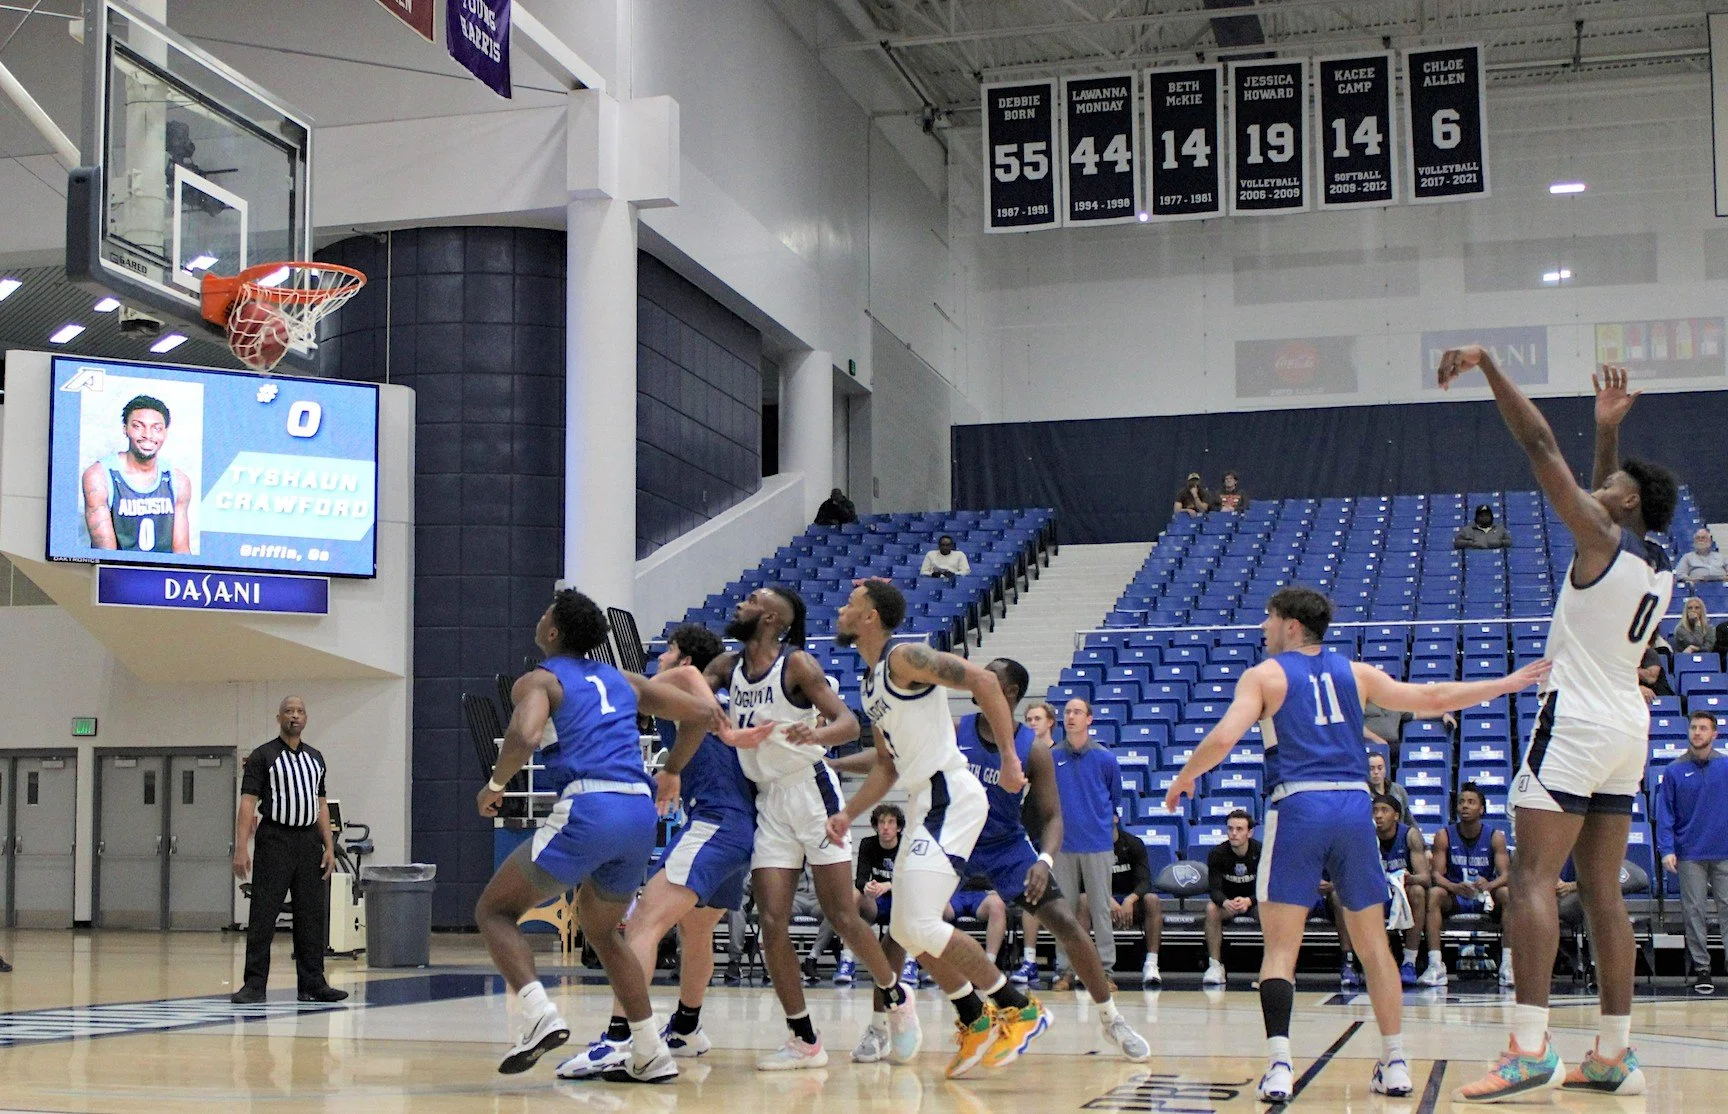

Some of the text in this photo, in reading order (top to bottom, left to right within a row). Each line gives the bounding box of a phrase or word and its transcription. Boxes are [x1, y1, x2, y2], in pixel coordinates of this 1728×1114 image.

[458, 14, 501, 63] HARRIS
[1334, 67, 1376, 81] KACEE
[1422, 59, 1464, 73] CHLOE
[1168, 80, 1200, 93] BETH
[1243, 74, 1294, 87] JESSICA
[1337, 81, 1373, 94] CAMP
[1423, 72, 1465, 87] ALLEN
[998, 95, 1041, 109] DEBBIE
[1072, 86, 1128, 101] LAWANNA
[1166, 94, 1203, 107] McKIE
[1243, 87, 1294, 101] HOWARD
[1004, 108, 1036, 121] BORN
[1075, 100, 1125, 114] MONDAY
[1331, 115, 1383, 158] 14
[1431, 108, 1462, 149] 6
[1161, 128, 1211, 169] 14
[1246, 122, 1295, 164] 19
[994, 141, 1049, 183] 55
[1070, 133, 1132, 176] 44
[1334, 170, 1382, 182] SOFTBALL
[1417, 162, 1480, 176] VOLLEYBALL
[1240, 177, 1300, 188] VOLLEYBALL
[229, 465, 358, 492] TYSHAUN
[118, 497, 174, 516] AUGUSTA
[215, 490, 369, 519] CRAWFORD
[138, 517, 155, 551] 0
[164, 573, 260, 607] DASANI
[1628, 591, 1659, 643] 0
[584, 675, 616, 715] 1
[1308, 672, 1346, 726] 11
